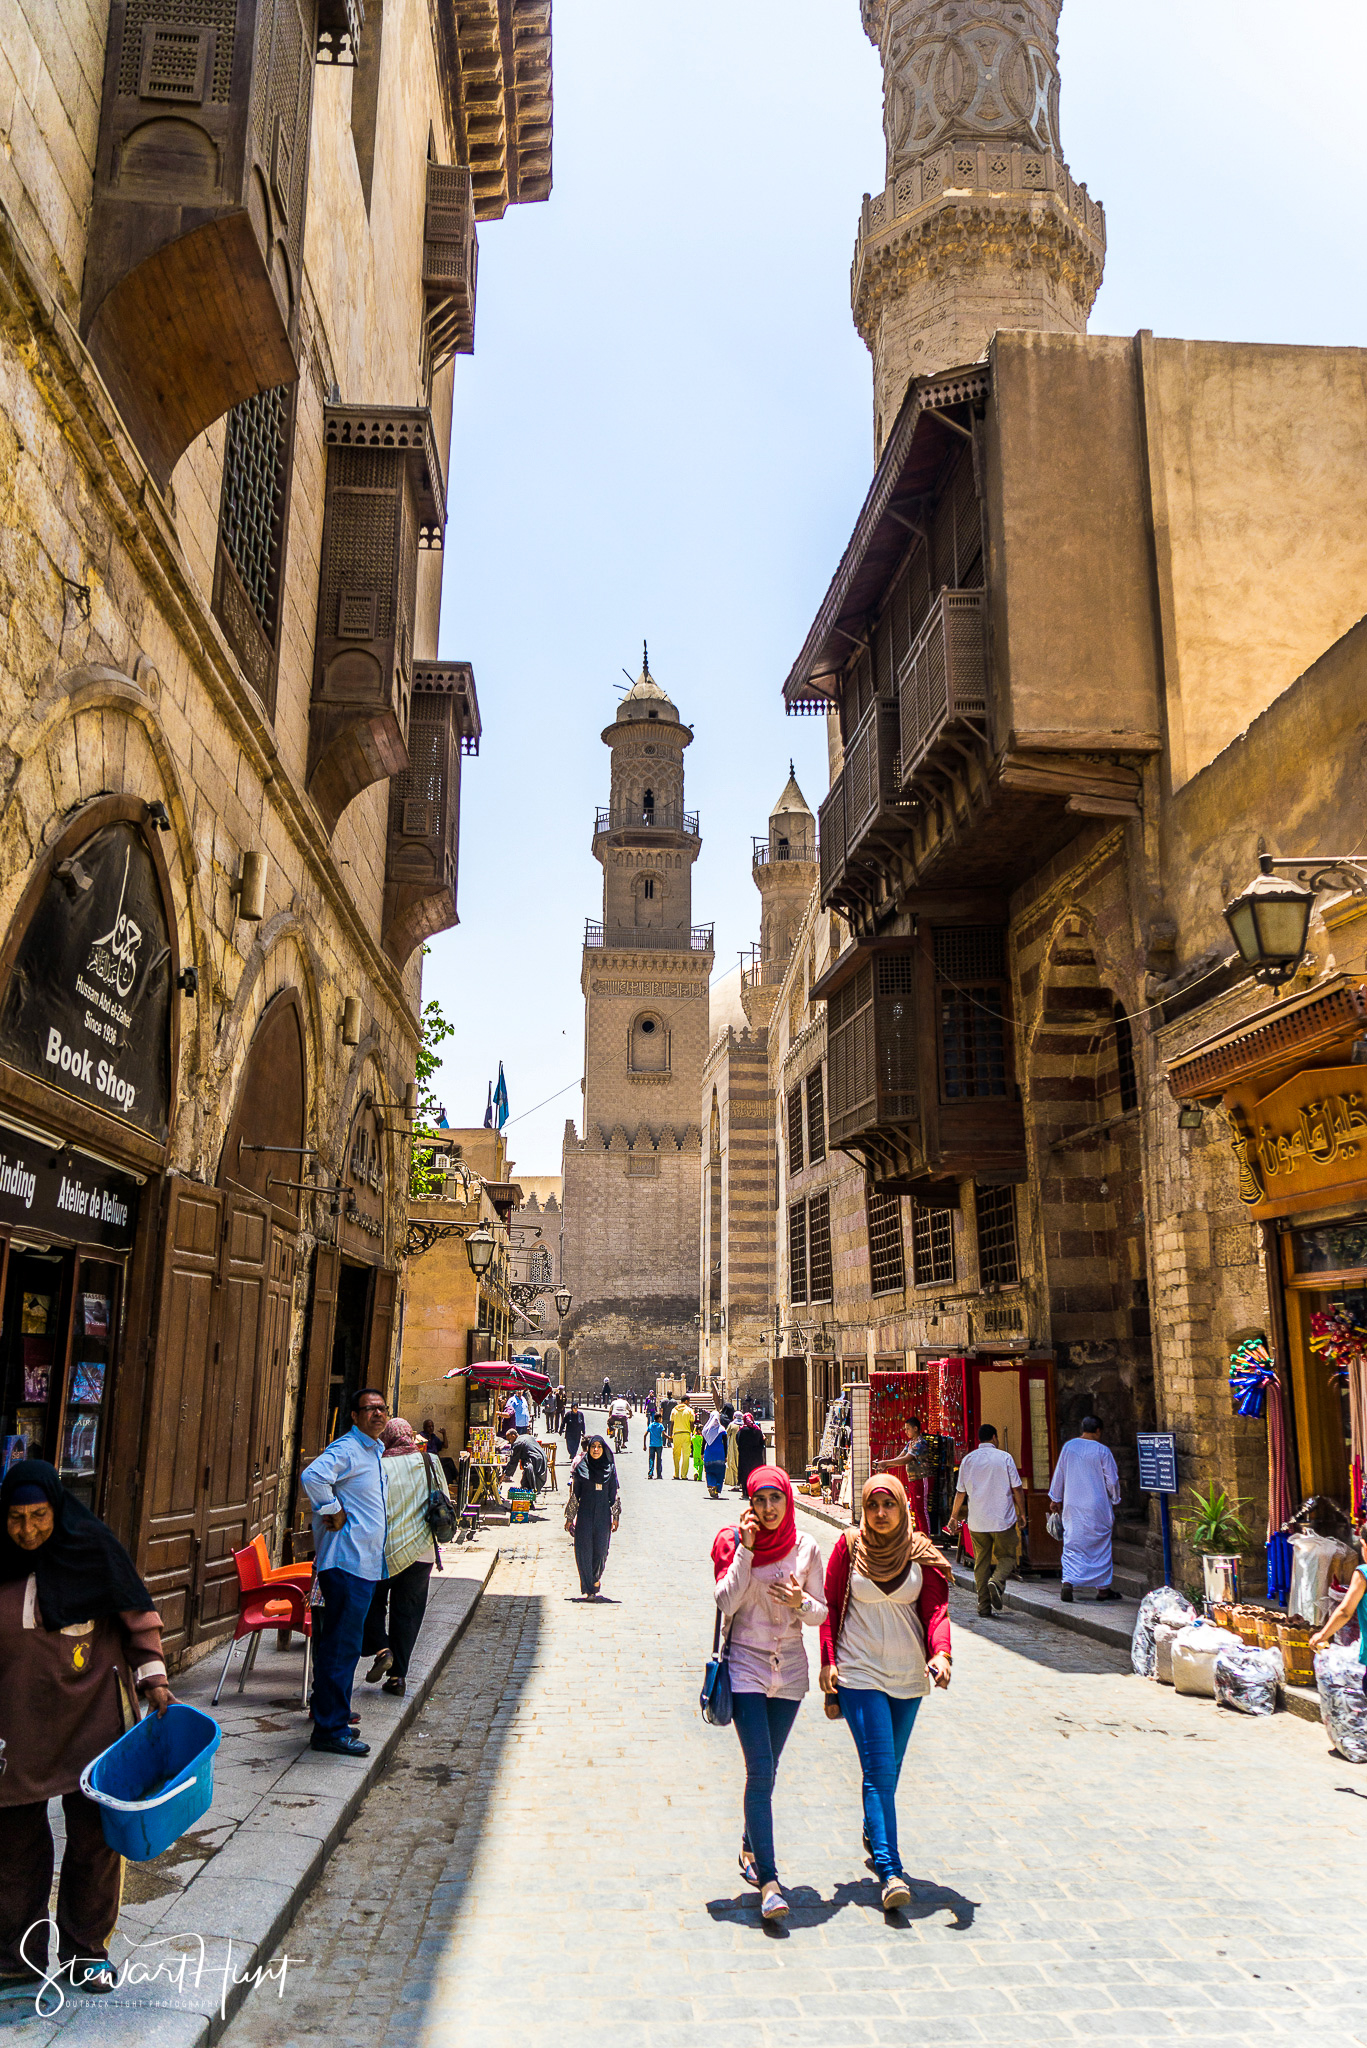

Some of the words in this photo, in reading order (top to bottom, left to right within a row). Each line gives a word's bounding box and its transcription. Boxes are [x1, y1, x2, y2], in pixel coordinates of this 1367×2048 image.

[75, 973, 100, 1006] Hussam
[98, 991, 112, 1015] Abd
[110, 1002, 133, 1029] el-Zaher
[84, 1009, 102, 1036] Since
[102, 1023, 118, 1046] 1936
[45, 1026, 93, 1085] Book
[95, 1059, 137, 1113] Shop
[0, 1153, 37, 1209] inding
[56, 1175, 90, 1216] Atelier
[89, 1186, 101, 1220] de
[101, 1189, 129, 1228] Reliure
